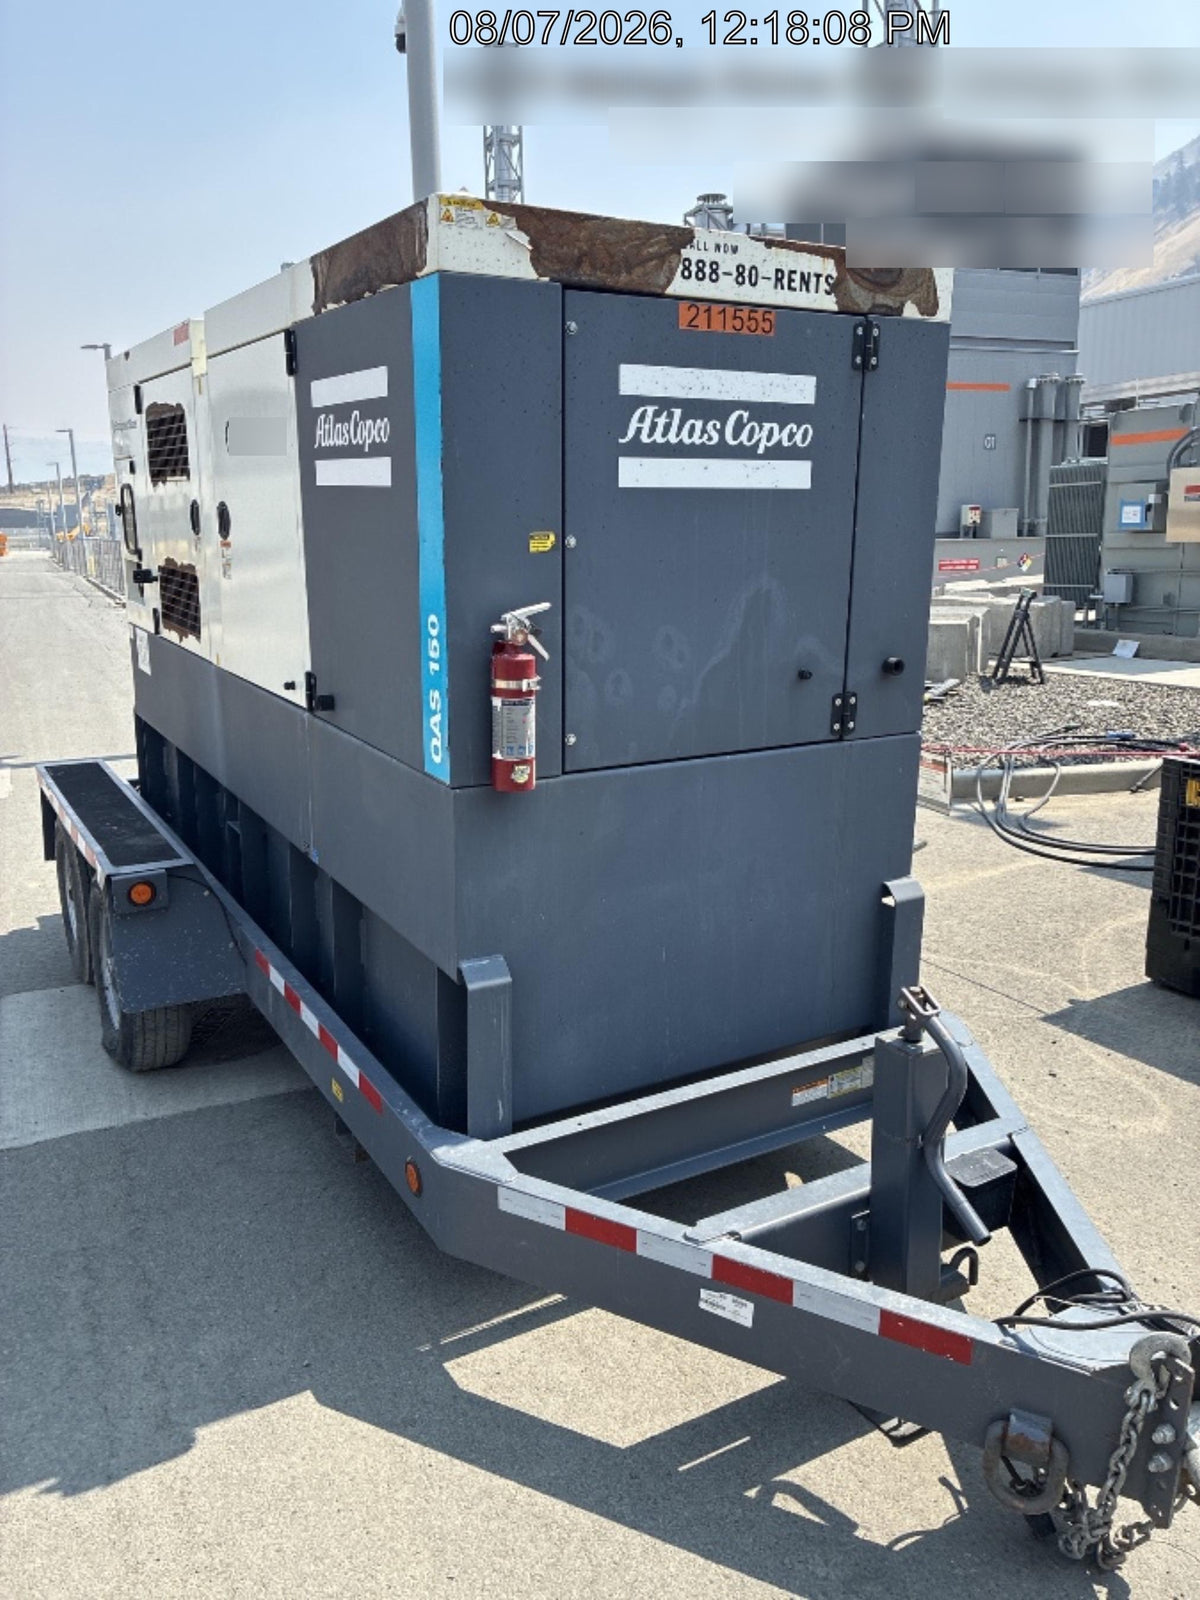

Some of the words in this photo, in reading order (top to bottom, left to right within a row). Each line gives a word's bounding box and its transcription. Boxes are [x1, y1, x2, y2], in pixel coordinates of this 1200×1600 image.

[714, 243, 738, 255] NOW
[686, 303, 773, 334] 211555
[314, 413, 349, 449] Atlas
[350, 410, 390, 452] Copco
[618, 405, 721, 445] Atlas
[725, 408, 813, 454] Copco
[427, 614, 440, 677] 150
